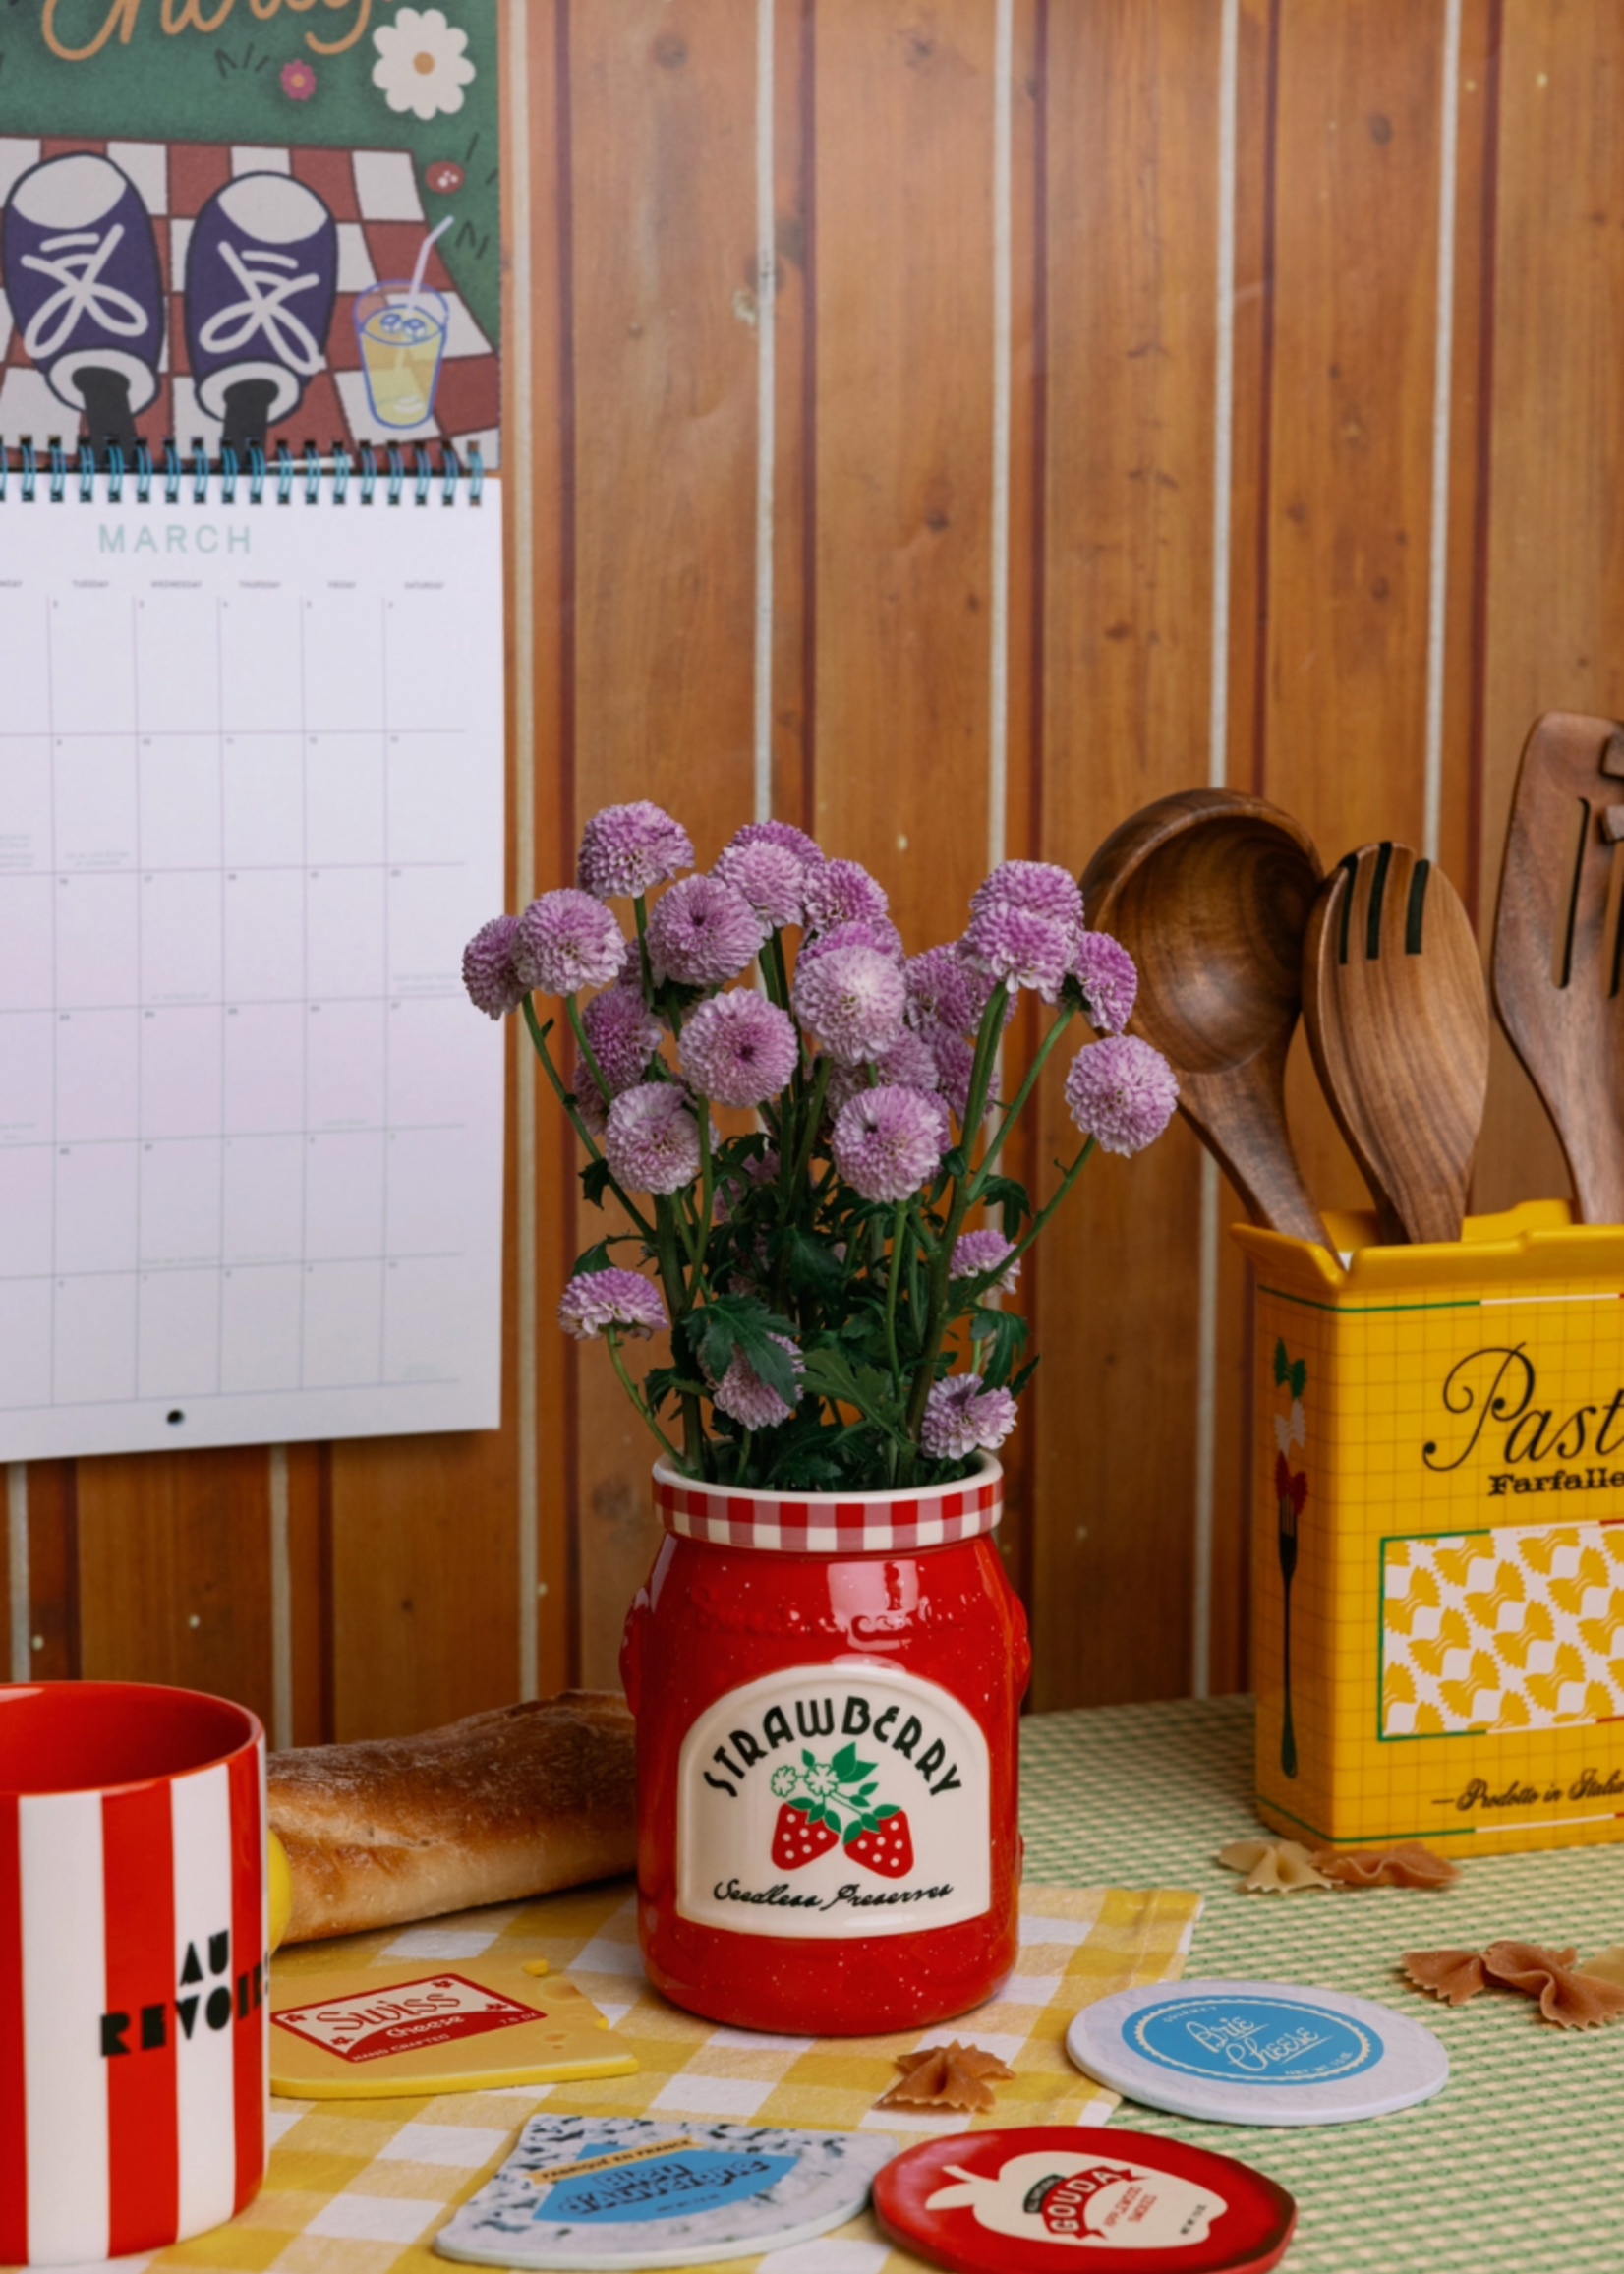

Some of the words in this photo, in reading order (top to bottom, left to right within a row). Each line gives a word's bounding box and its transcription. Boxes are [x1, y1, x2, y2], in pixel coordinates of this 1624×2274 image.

[99, 523, 251, 554] MARCH
[703, 1695, 962, 1797] STRAWBERRY
[1543, 1783, 1561, 1803] in
[714, 1879, 822, 1906] Seedless
[819, 1883, 954, 1911] Preserves
[179, 1929, 229, 1987] AU
[386, 2015, 464, 2038] Cheese
[391, 2033, 450, 2052] CRAFTED
[1186, 2017, 1255, 2053] Brie
[1226, 2027, 1319, 2071] Cheese
[613, 2152, 634, 2162] EN
[636, 2138, 690, 2156] FRANCE
[1047, 2169, 1124, 2233] GOUDA
